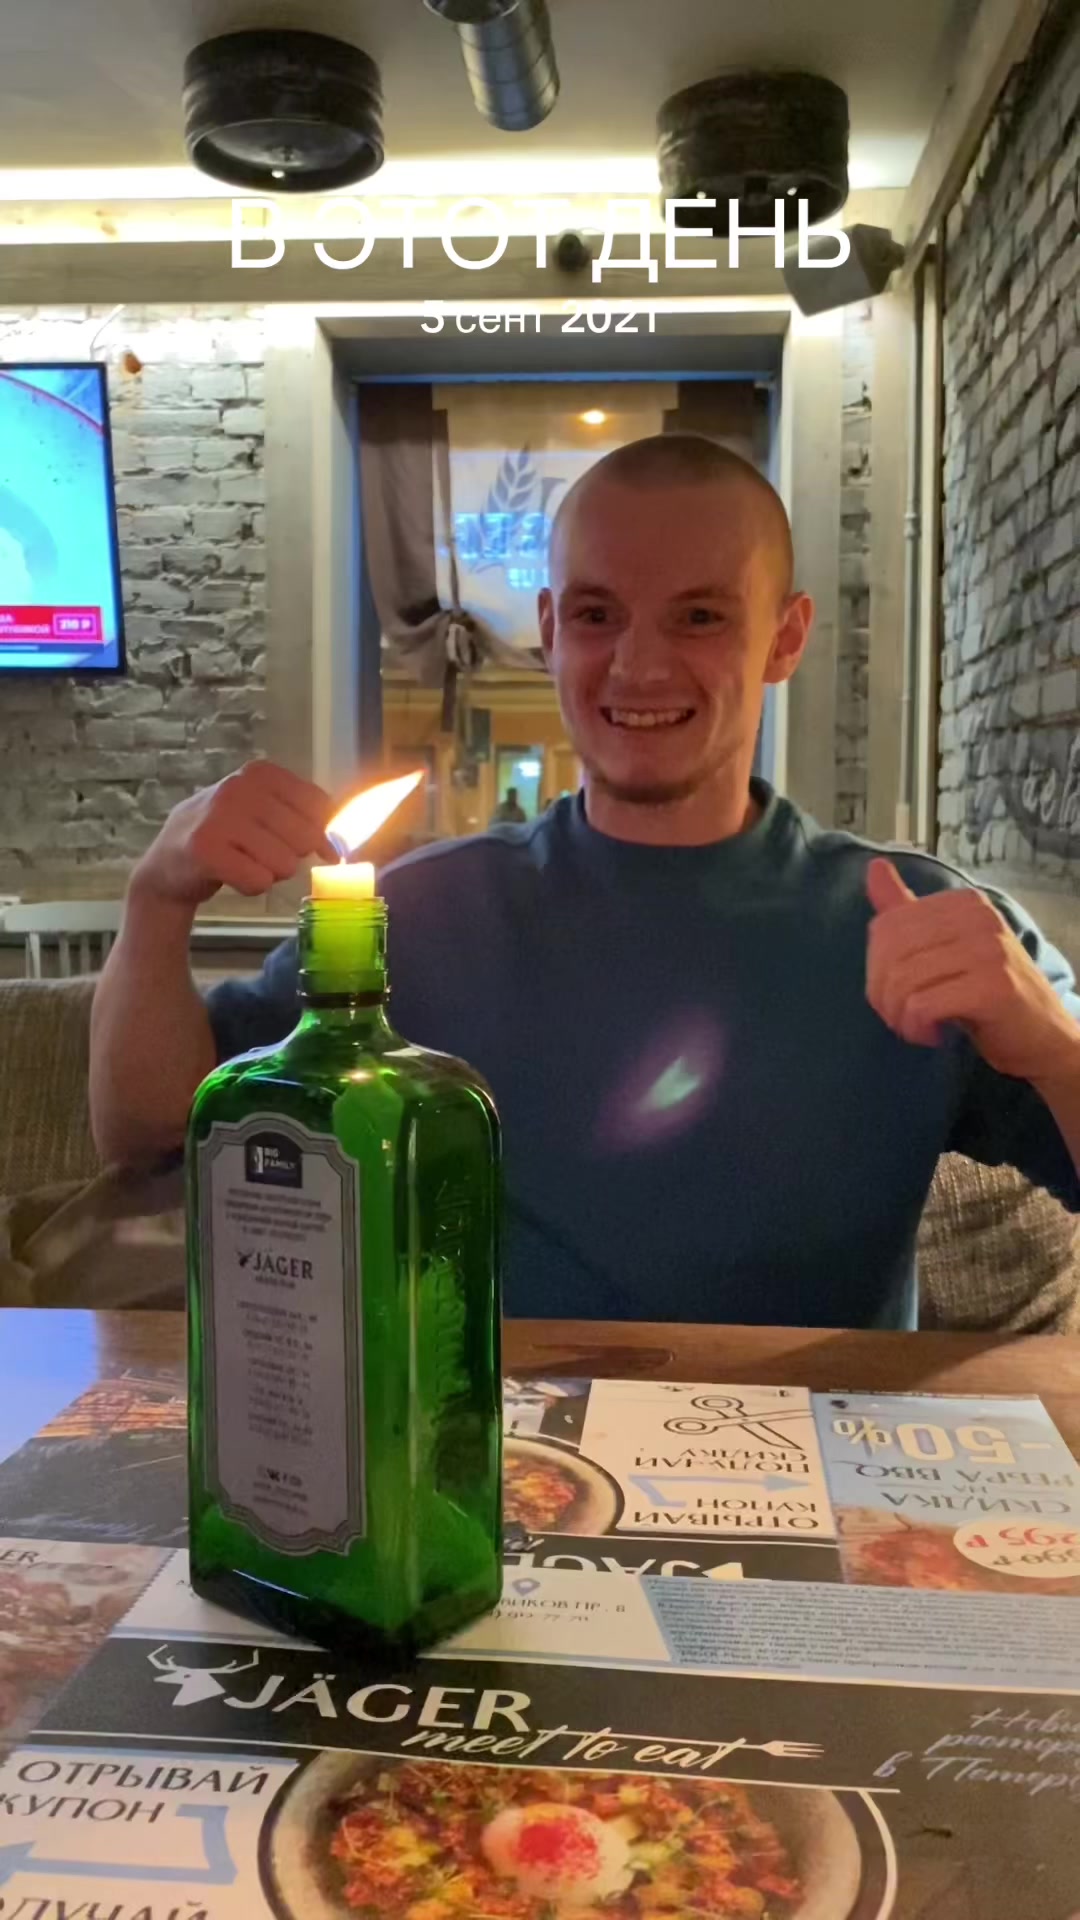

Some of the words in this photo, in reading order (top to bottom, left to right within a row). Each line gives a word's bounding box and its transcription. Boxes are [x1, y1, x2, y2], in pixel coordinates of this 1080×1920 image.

[697, 1498, 817, 1513] КУПОН
[880, 1492, 1071, 1514] СКИДКА
[634, 1511, 819, 1530] ОТРЫВАЙ
[223, 1673, 531, 1733] JÄGER
[401, 1725, 568, 1759] meet
[562, 1727, 628, 1761] to
[633, 1737, 747, 1770] eat
[18, 1760, 269, 1794] ОТРЫВАЙ
[921, 1757, 1080, 1796] Петер
[0, 1793, 165, 1823] КУПОН
[0, 1897, 208, 1920] ЛУЧАЙ
